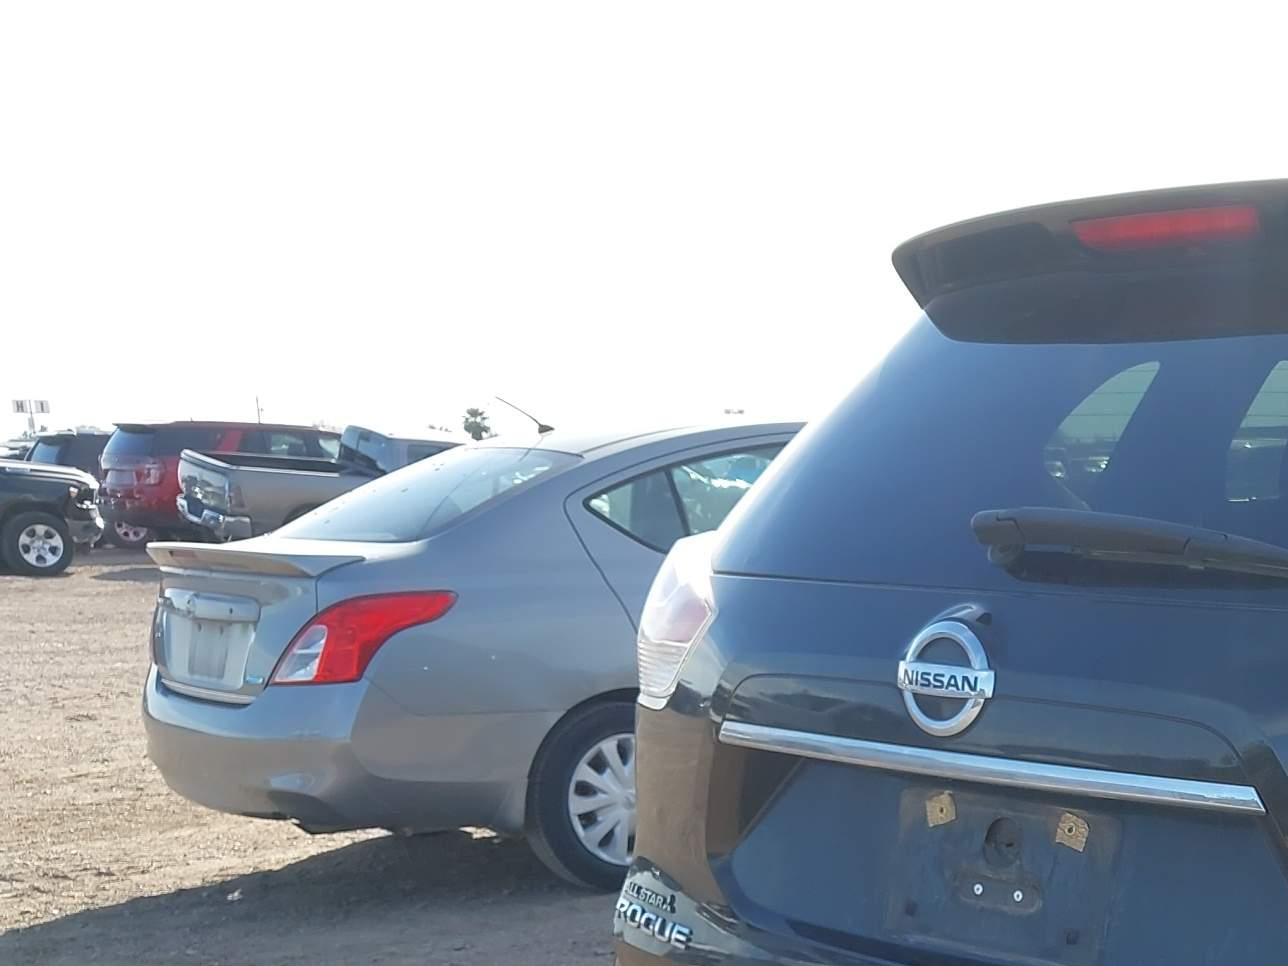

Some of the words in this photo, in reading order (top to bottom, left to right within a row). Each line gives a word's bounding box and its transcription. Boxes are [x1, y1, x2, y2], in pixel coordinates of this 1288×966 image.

[903, 668, 979, 692] NISSAN
[639, 887, 665, 909] STAR
[613, 899, 692, 950] ROGUE
